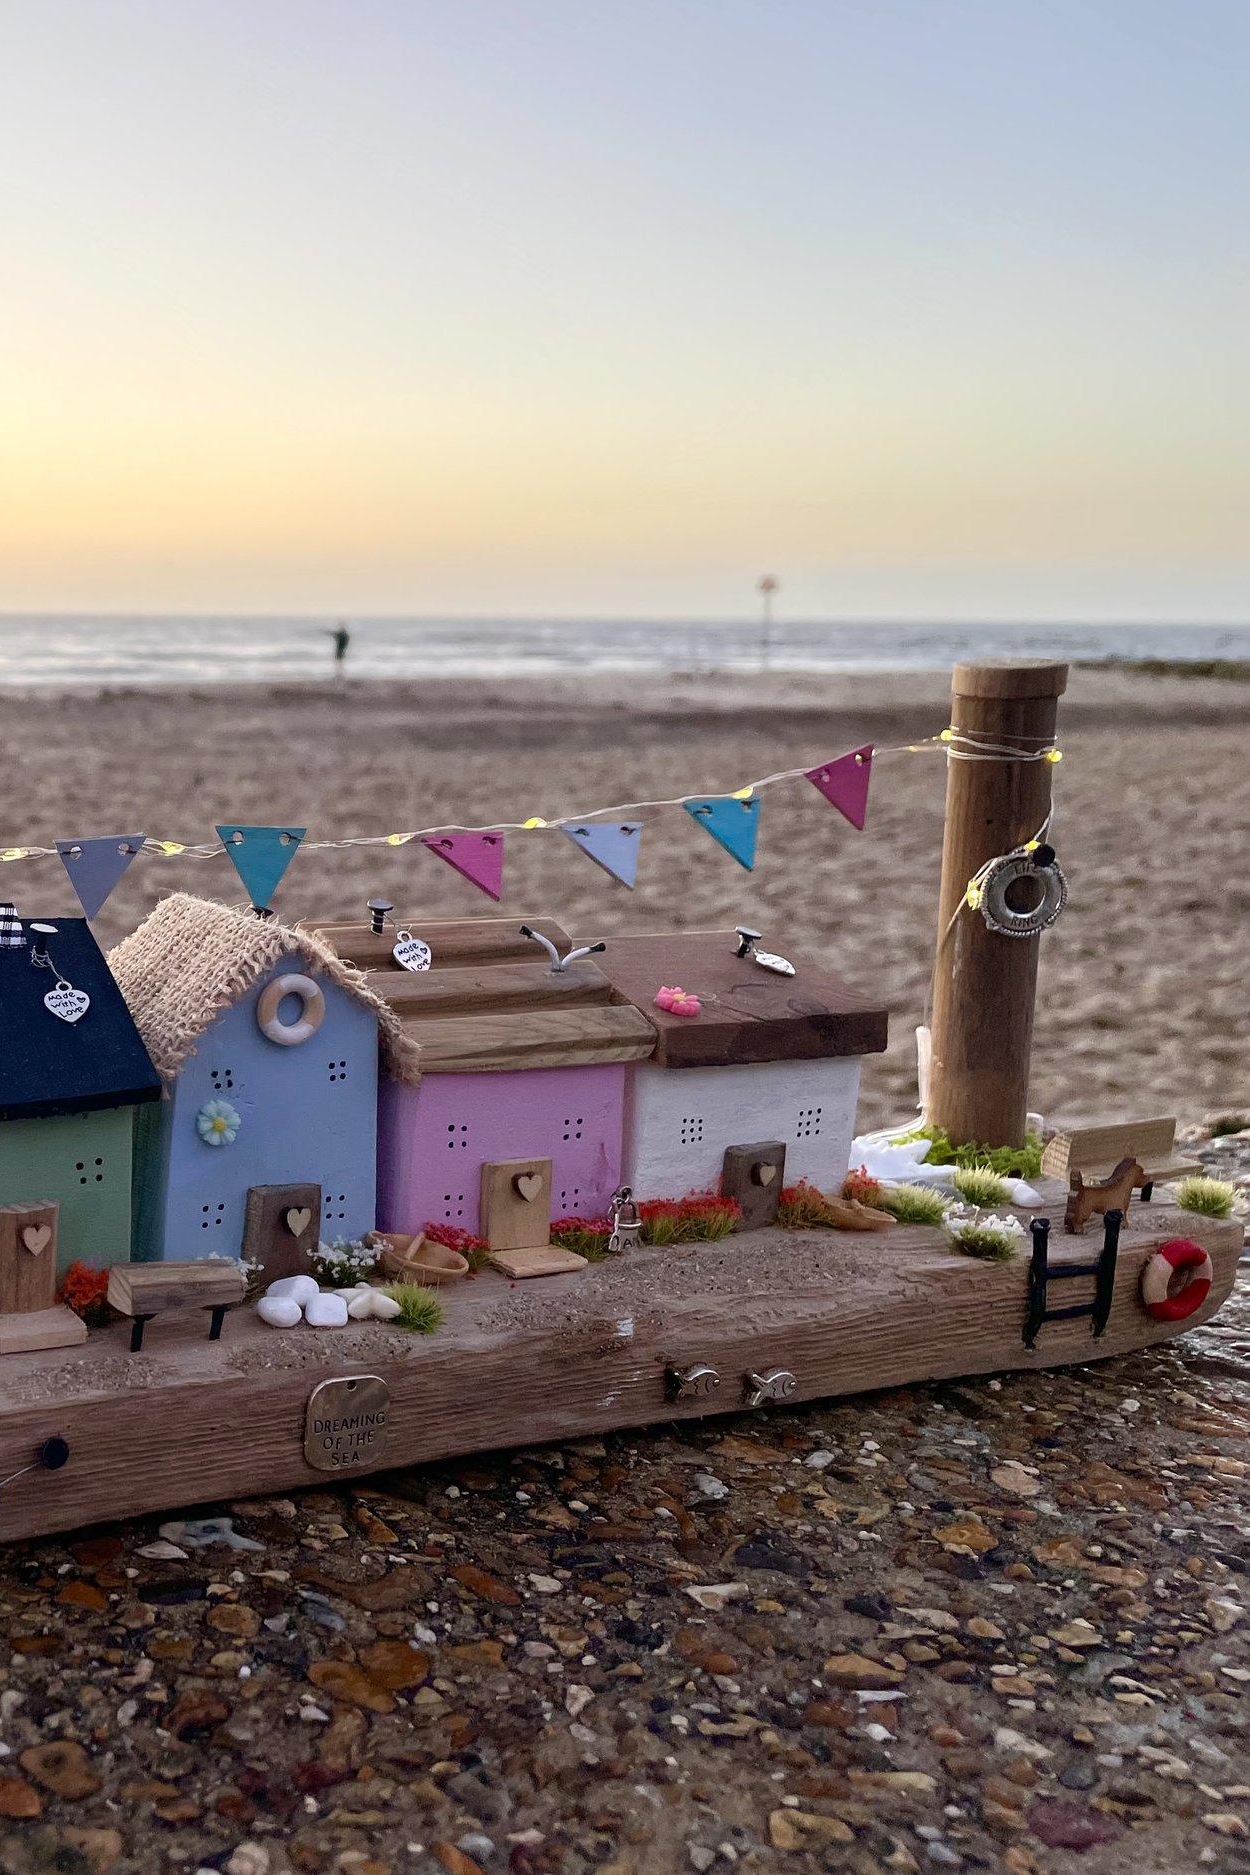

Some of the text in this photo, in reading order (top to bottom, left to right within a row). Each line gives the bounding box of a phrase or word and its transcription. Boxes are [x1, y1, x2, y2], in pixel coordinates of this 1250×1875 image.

[1010, 913, 1038, 927] RING
[58, 1006, 84, 1018] Love
[313, 1411, 386, 1435] DREAMING
[322, 1429, 376, 1450] OF THE
[331, 1450, 360, 1466] SEA
